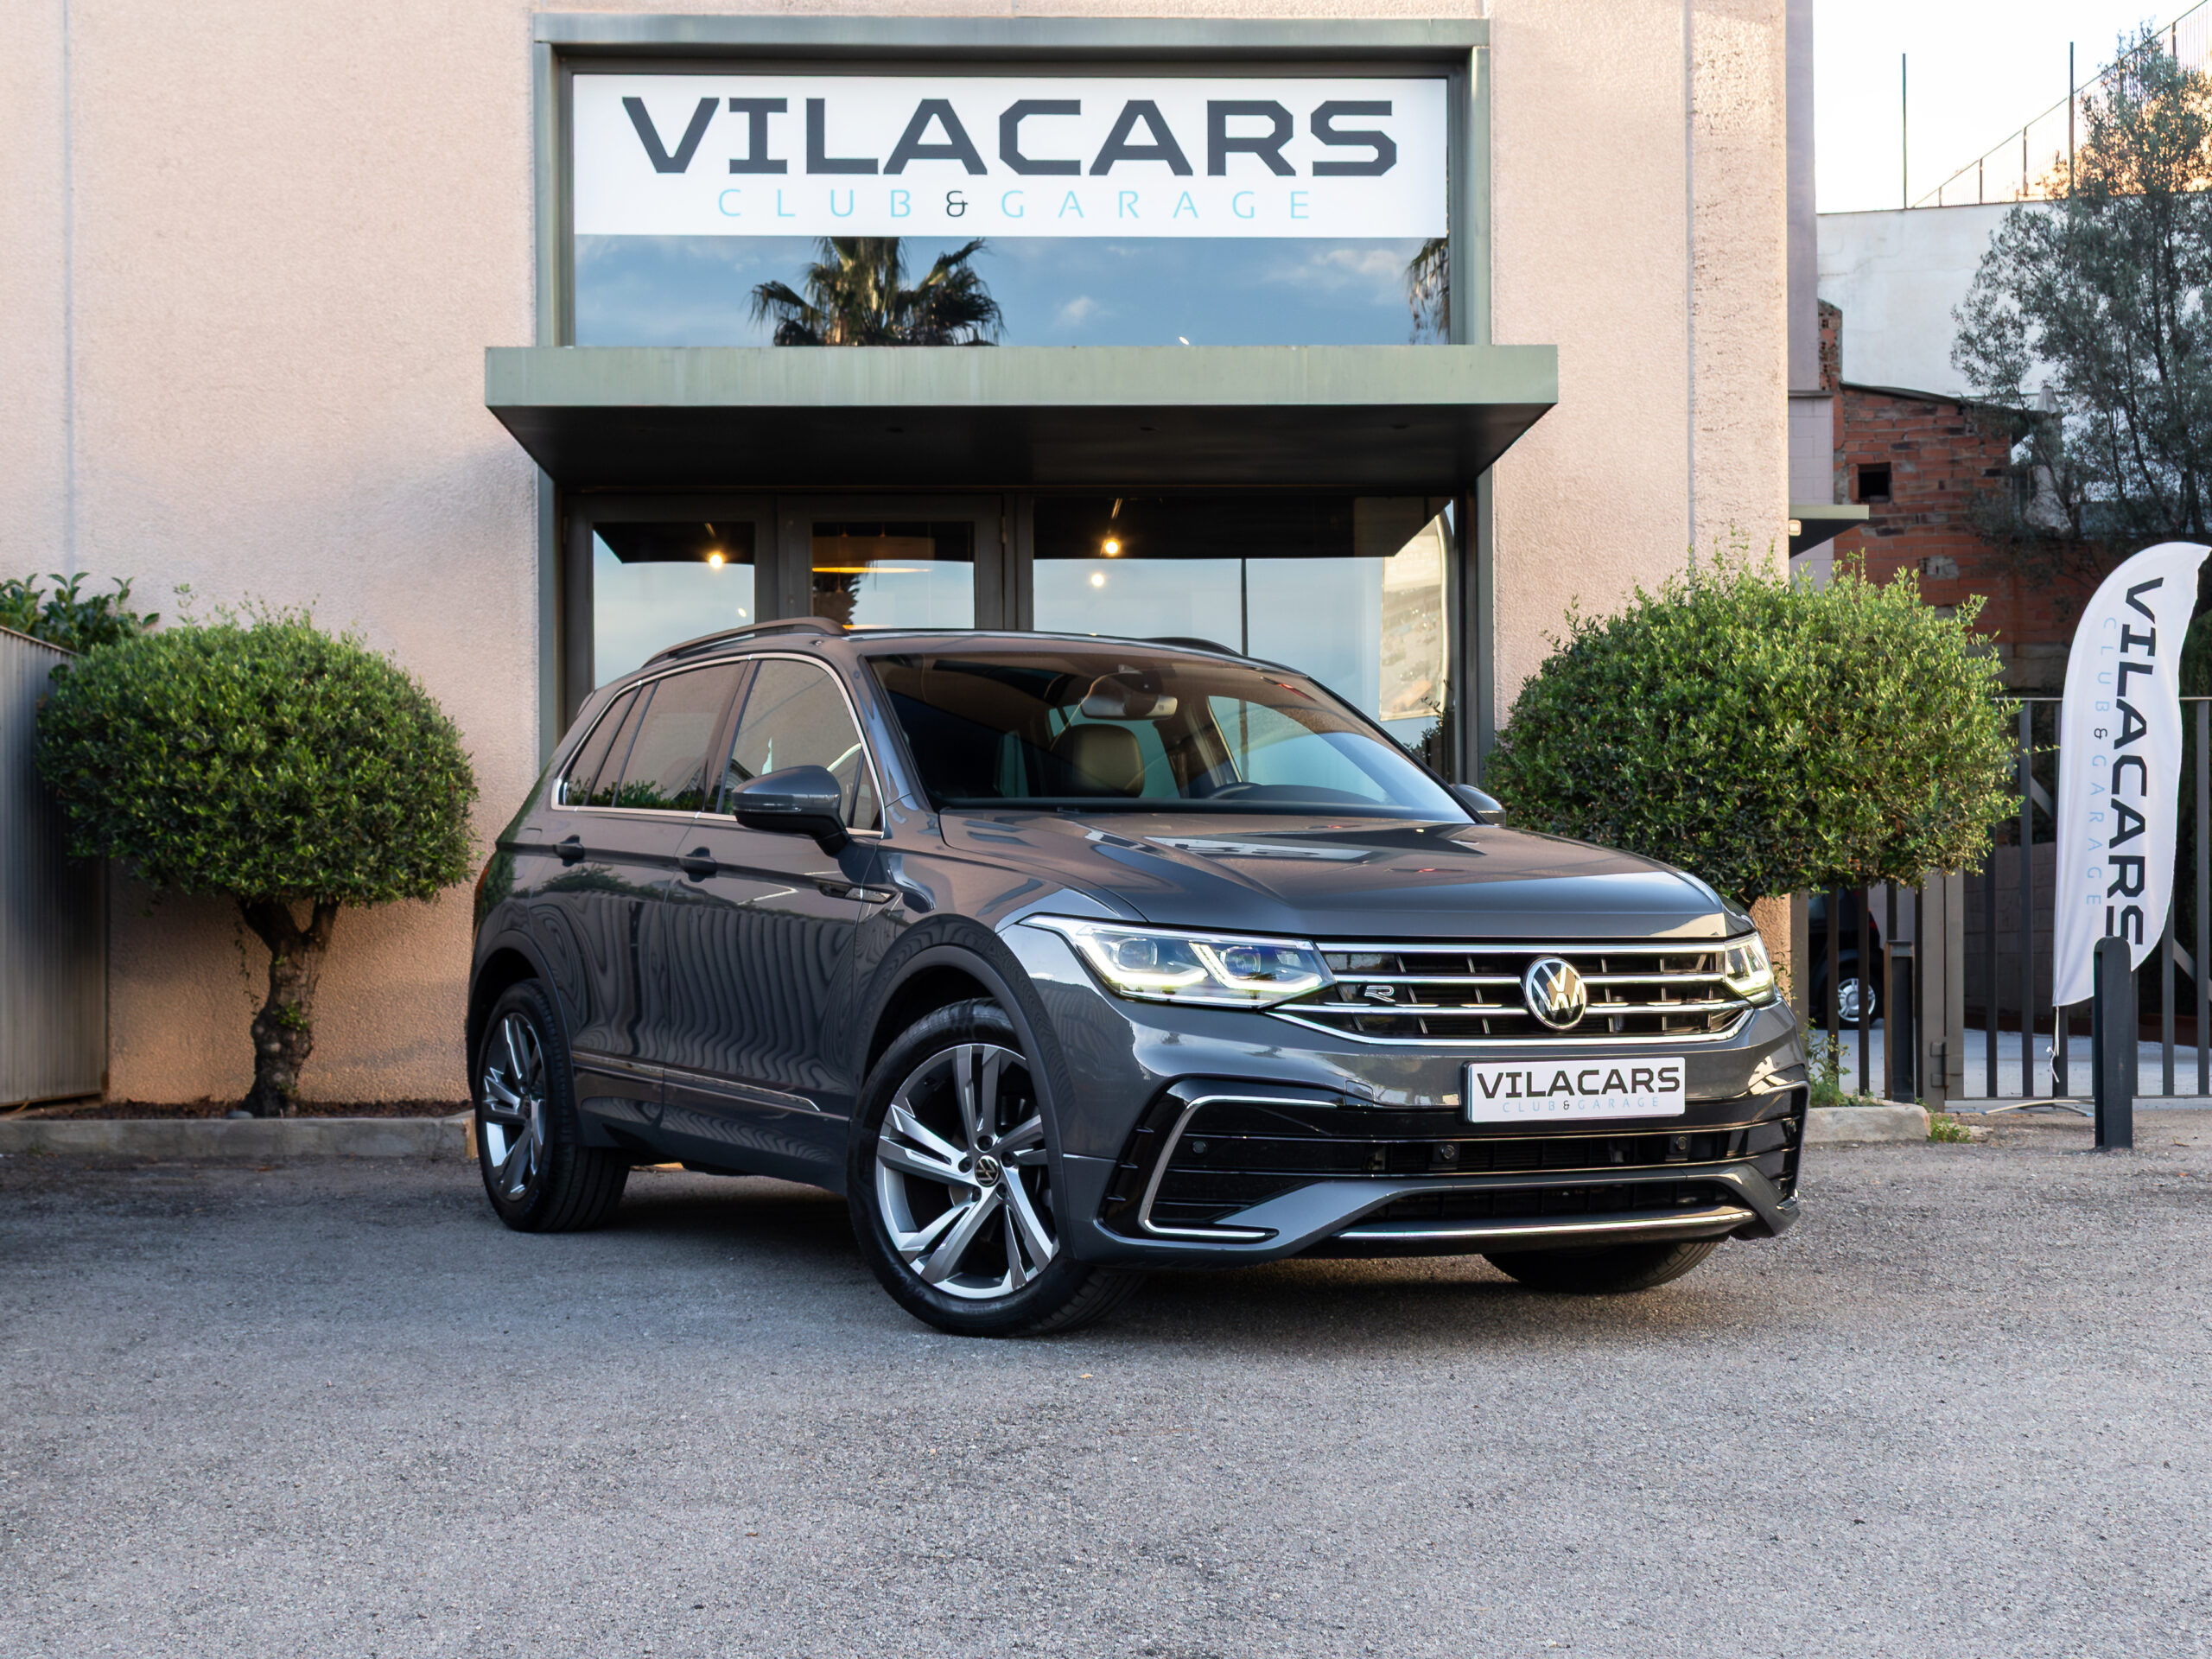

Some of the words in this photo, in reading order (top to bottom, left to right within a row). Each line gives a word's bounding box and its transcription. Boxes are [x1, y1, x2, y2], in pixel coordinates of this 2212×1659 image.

[622, 97, 1397, 176] VILACARS
[2107, 576, 2164, 945] VILACARS
[1477, 1067, 1680, 1099] VILACARS
